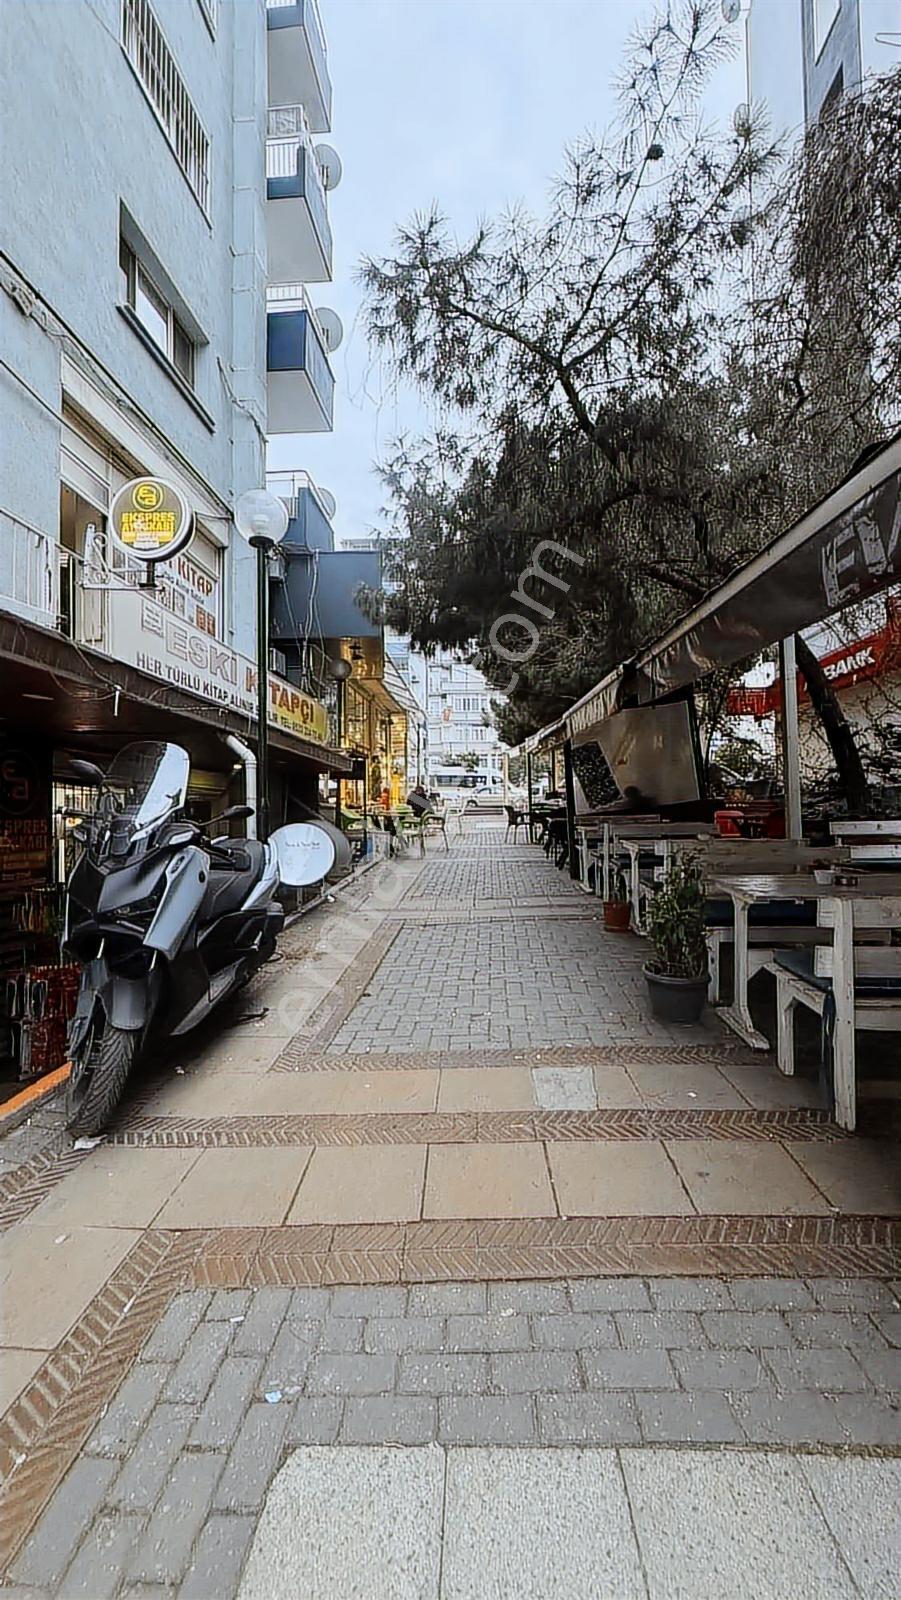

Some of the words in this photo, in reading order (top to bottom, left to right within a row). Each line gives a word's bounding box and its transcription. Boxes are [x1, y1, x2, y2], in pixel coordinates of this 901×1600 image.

[136, 651, 162, 676] HER
[165, 663, 200, 690] TÜRLÜ
[203, 681, 229, 701] KİTAP
[246, 666, 314, 724] KTAPÇI
